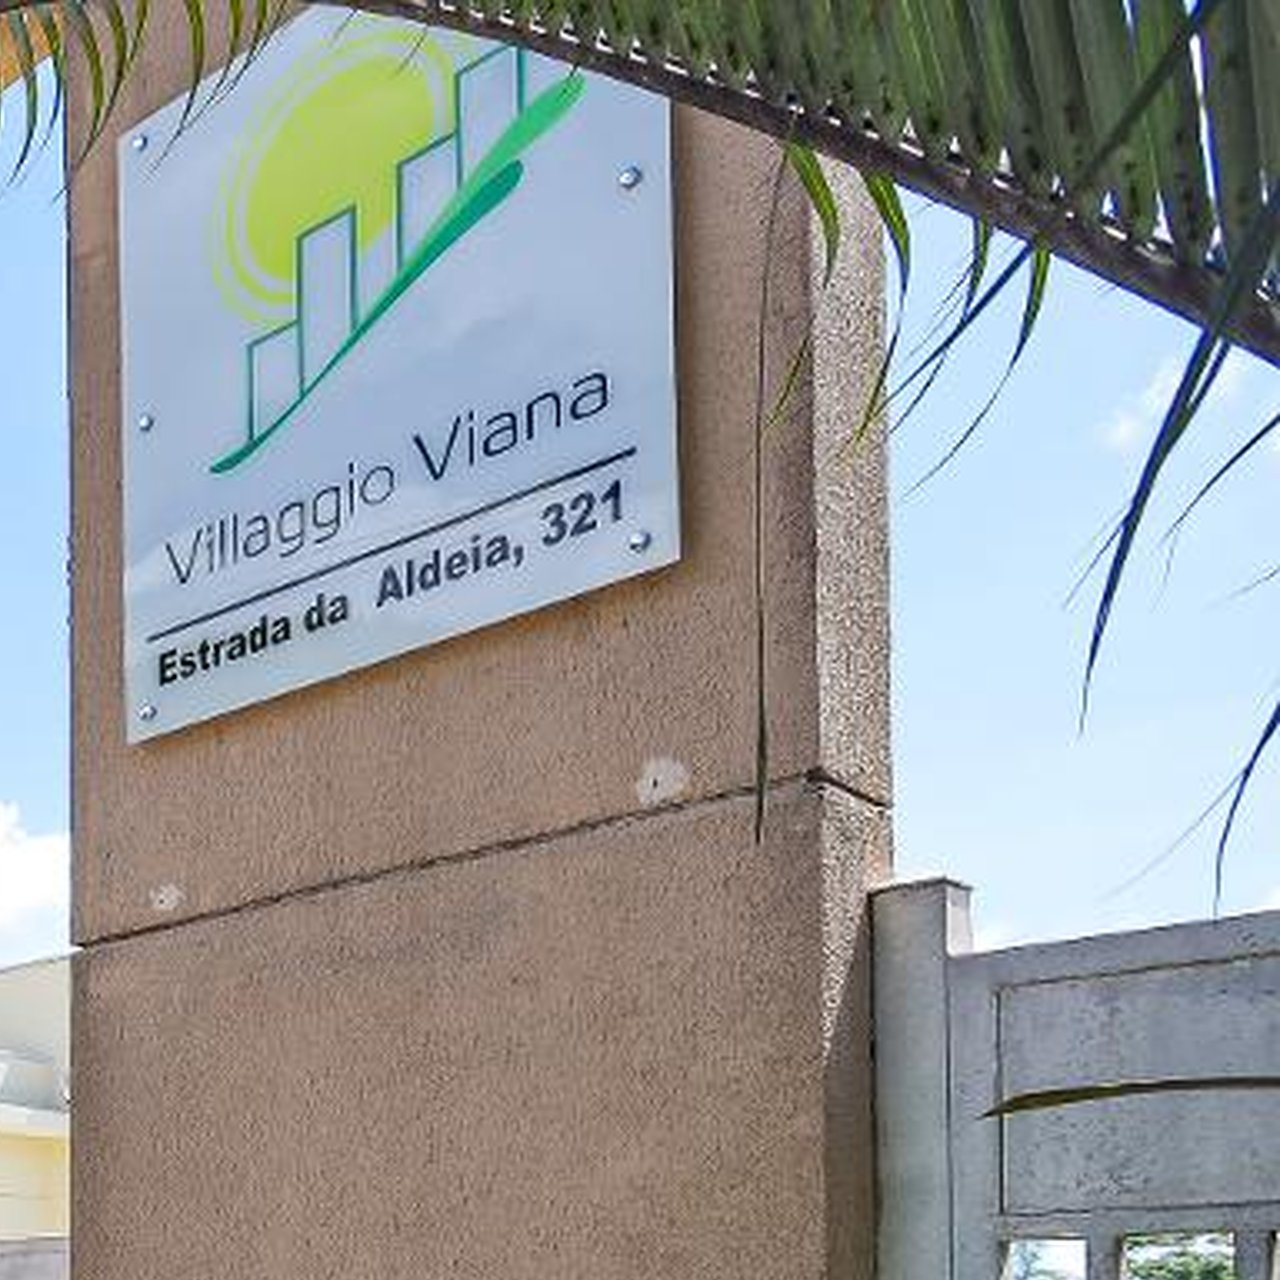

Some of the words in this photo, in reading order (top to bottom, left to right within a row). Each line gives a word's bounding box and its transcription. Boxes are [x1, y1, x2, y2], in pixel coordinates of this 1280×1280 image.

[163, 458, 396, 586] Villaggio
[413, 367, 611, 484] Viana
[157, 616, 292, 687] Estrada
[304, 585, 351, 632] da
[376, 530, 526, 609] Aldeia,
[542, 480, 626, 549] 321
